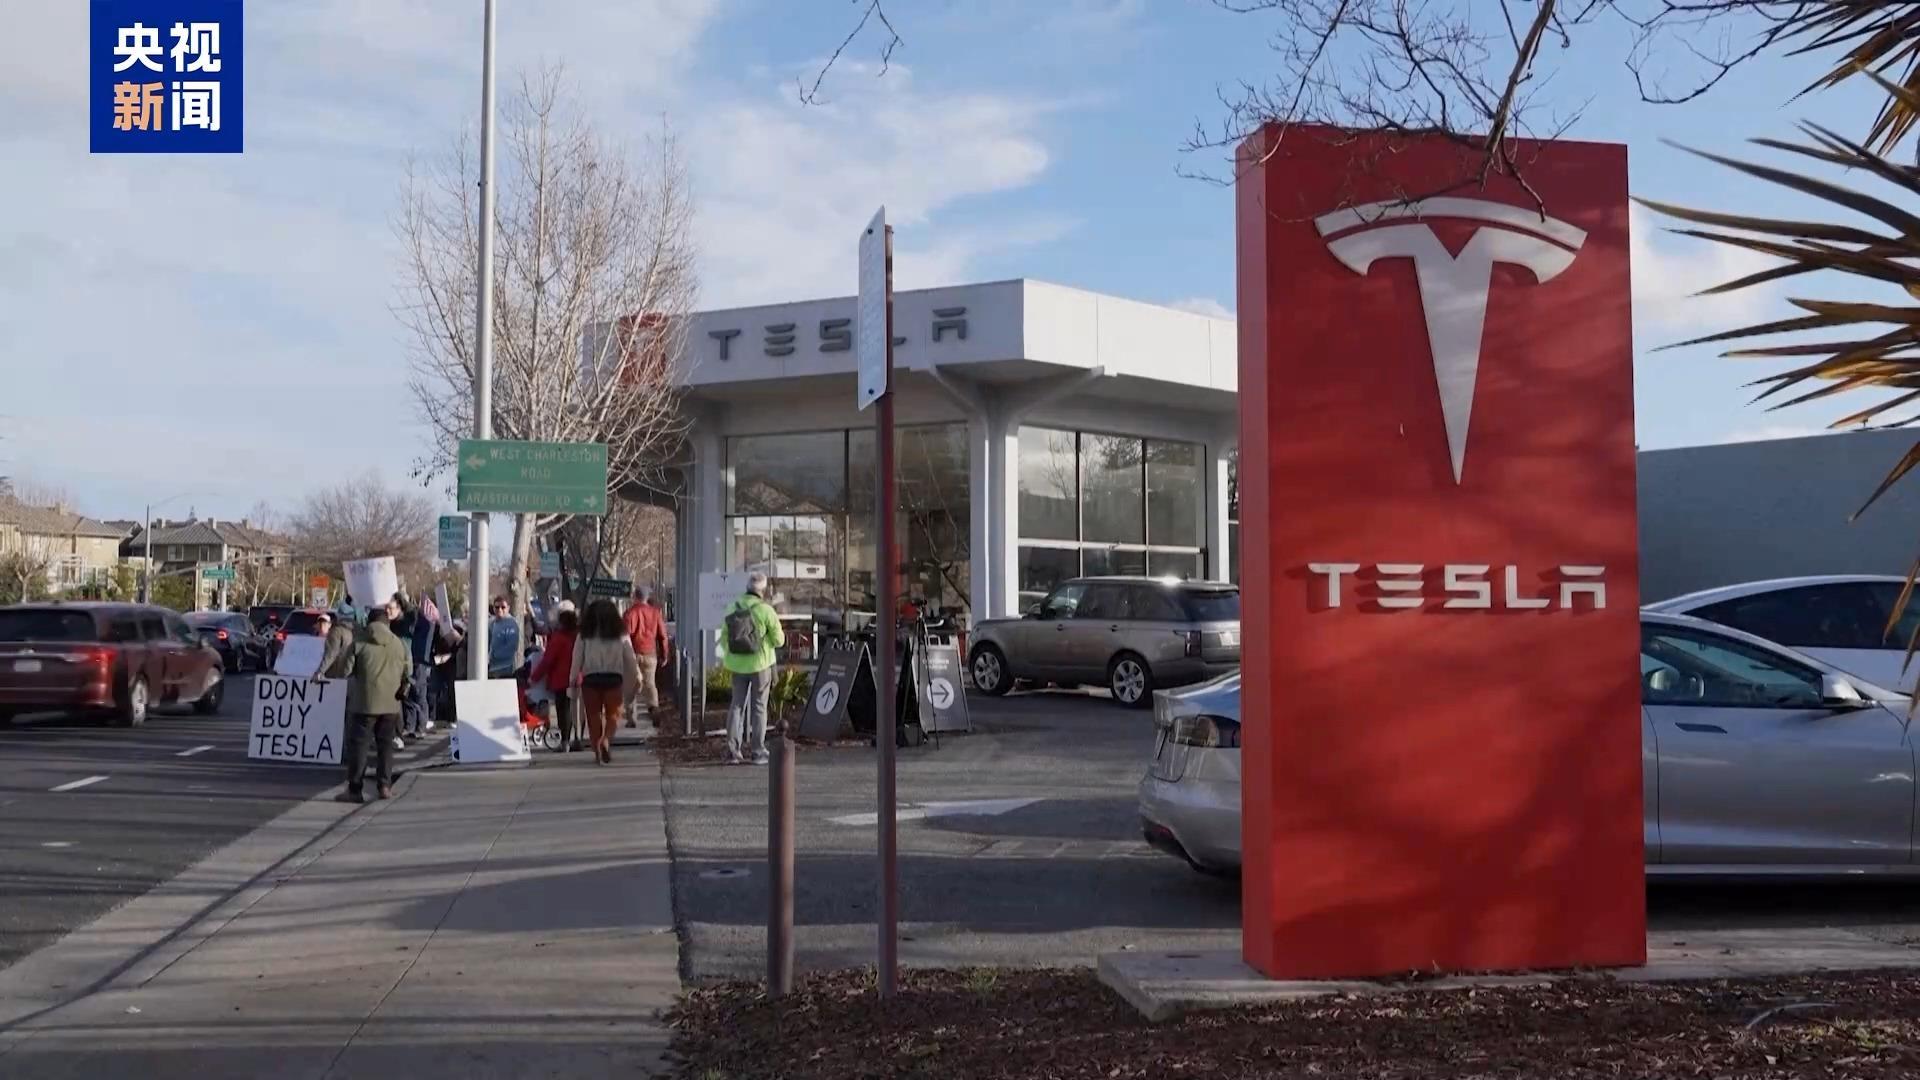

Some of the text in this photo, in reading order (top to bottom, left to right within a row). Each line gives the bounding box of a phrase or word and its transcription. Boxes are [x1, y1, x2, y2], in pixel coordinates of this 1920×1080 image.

[708, 306, 967, 361] TESA
[490, 447, 600, 464] WEST CHARLESTON
[520, 466, 551, 480] ROAD
[1307, 562, 1606, 610] TESLA
[258, 677, 331, 703] DON'T
[262, 703, 312, 730] BUY
[255, 733, 334, 760] TESLA
